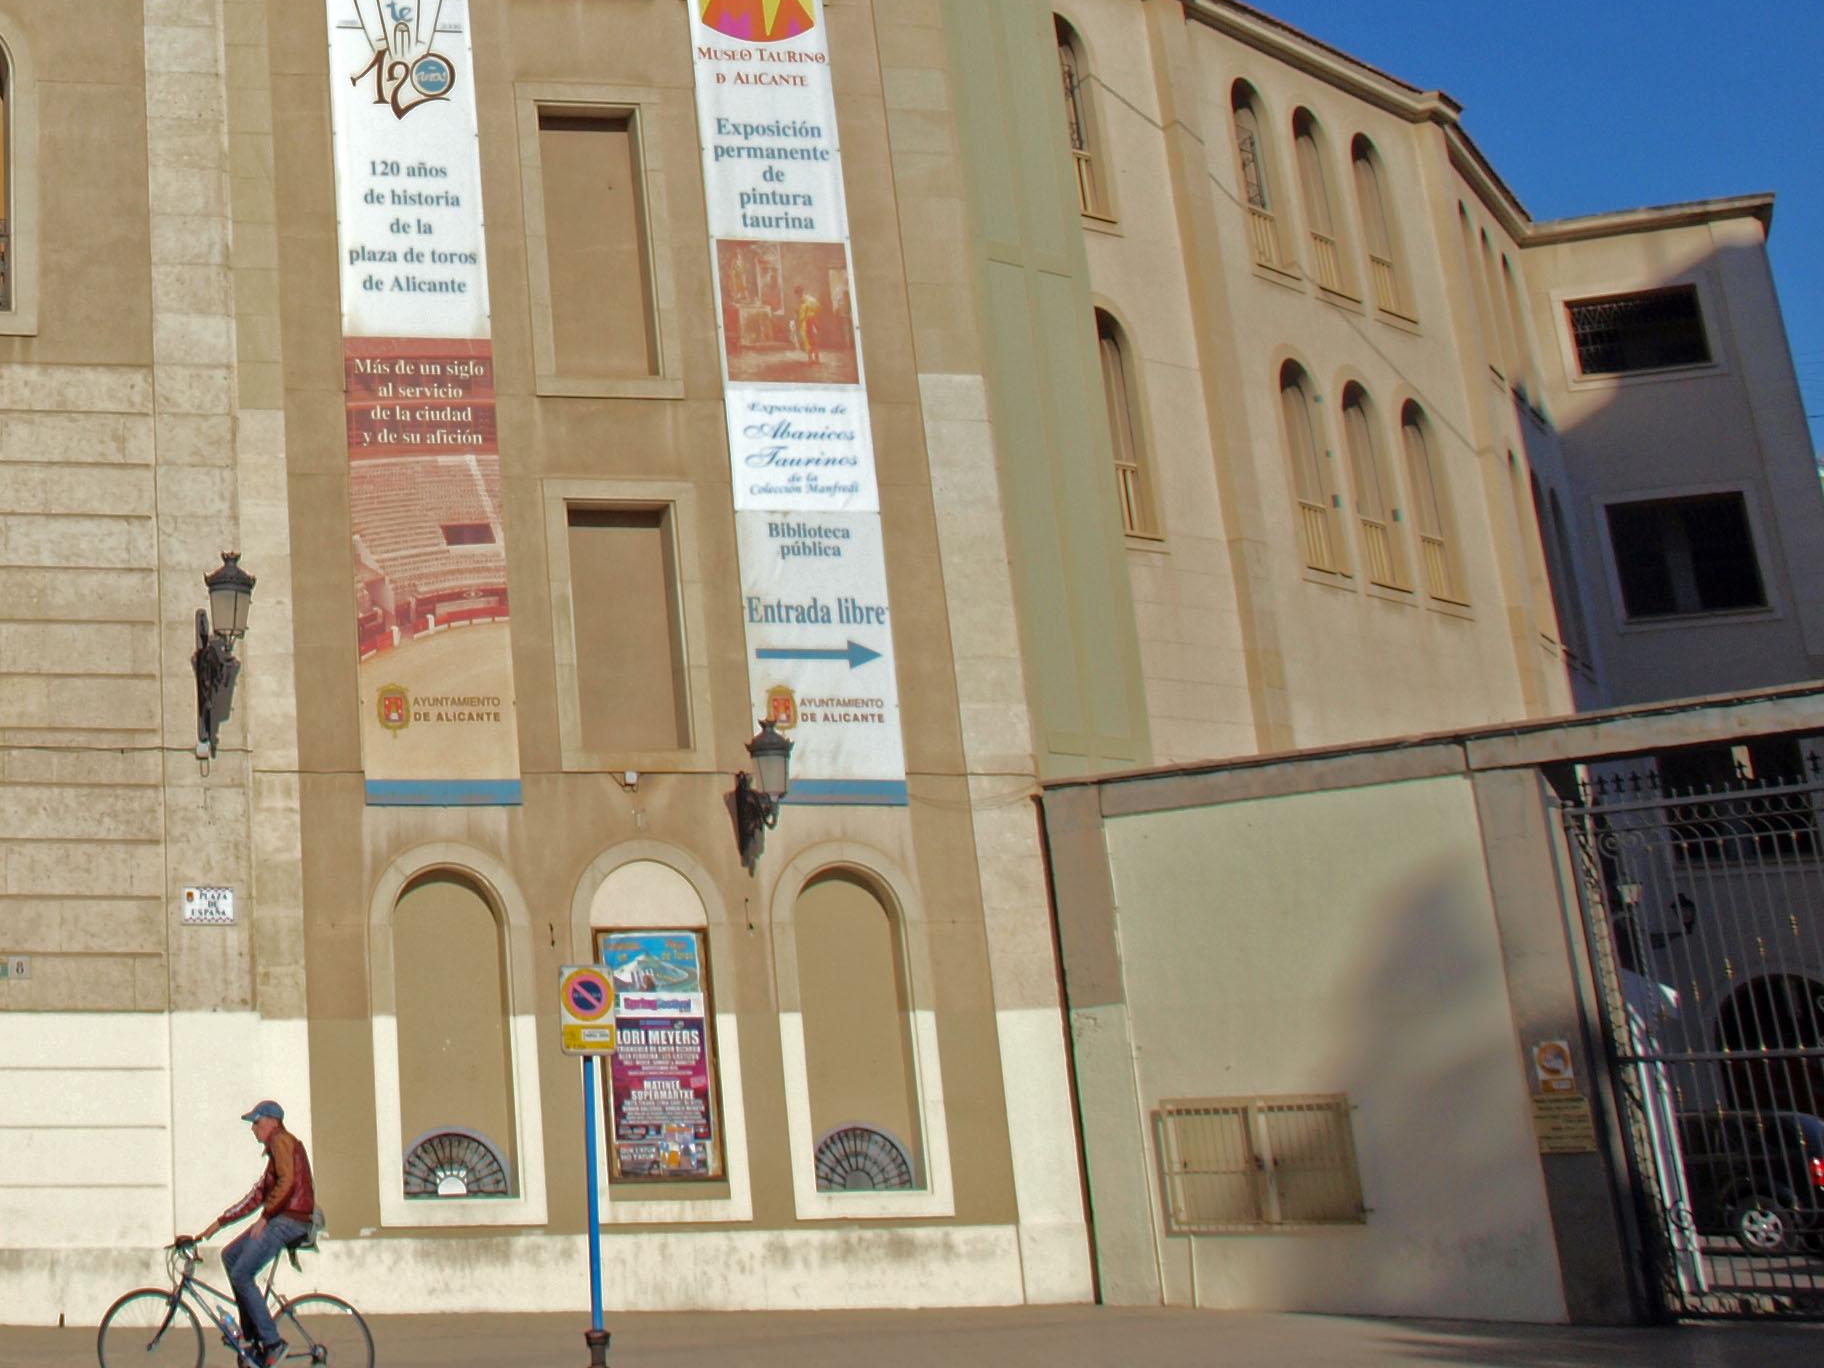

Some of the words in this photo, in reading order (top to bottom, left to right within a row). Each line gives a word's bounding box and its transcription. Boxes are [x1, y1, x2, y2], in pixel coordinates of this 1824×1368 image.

[350, 48, 456, 120] 120
[716, 118, 822, 140] Exposición
[713, 144, 830, 162] permanente
[370, 160, 400, 177] 120
[407, 160, 448, 178] años
[762, 166, 785, 183] de
[364, 189, 385, 206] de
[391, 190, 460, 207] historia
[739, 188, 813, 209] pintura
[390, 218, 411, 235] de
[417, 218, 433, 235] la
[741, 212, 815, 230] taurina
[349, 246, 398, 265] plaza
[403, 247, 425, 264] de
[431, 249, 477, 265] toros
[362, 276, 384, 292] de
[390, 277, 467, 294] Alicante
[354, 358, 390, 375] Más
[395, 359, 415, 375] de
[420, 363, 441, 376] un
[446, 359, 485, 379] siglo
[378, 382, 394, 397] al
[398, 384, 463, 399] servicio
[371, 405, 391, 420] de
[396, 406, 411, 421] la
[416, 406, 472, 422] ciudad
[747, 402, 826, 415] Exposición
[830, 404, 847, 415] de
[362, 432, 372, 446] y
[377, 429, 397, 444] de
[401, 432, 421, 445] su
[426, 429, 483, 446] afición
[744, 419, 856, 441] Abanicos
[745, 446, 859, 468] Taurinos
[787, 473, 801, 482] de
[768, 522, 850, 540] Biblioteca
[780, 541, 842, 559] pública
[747, 596, 832, 625] Entrada
[838, 597, 886, 625] libre
[413, 696, 501, 708] AYUNTAMIENTO
[800, 697, 884, 710] AYUNTAMIENTO
[414, 711, 431, 722] DE
[436, 711, 501, 723] ALICANTE
[801, 712, 818, 723] DE
[823, 713, 885, 724] ALICANTE
[16, 960, 24, 974] 8
[617, 1030, 645, 1044] LORI
[648, 1030, 699, 1045] MEYERS
